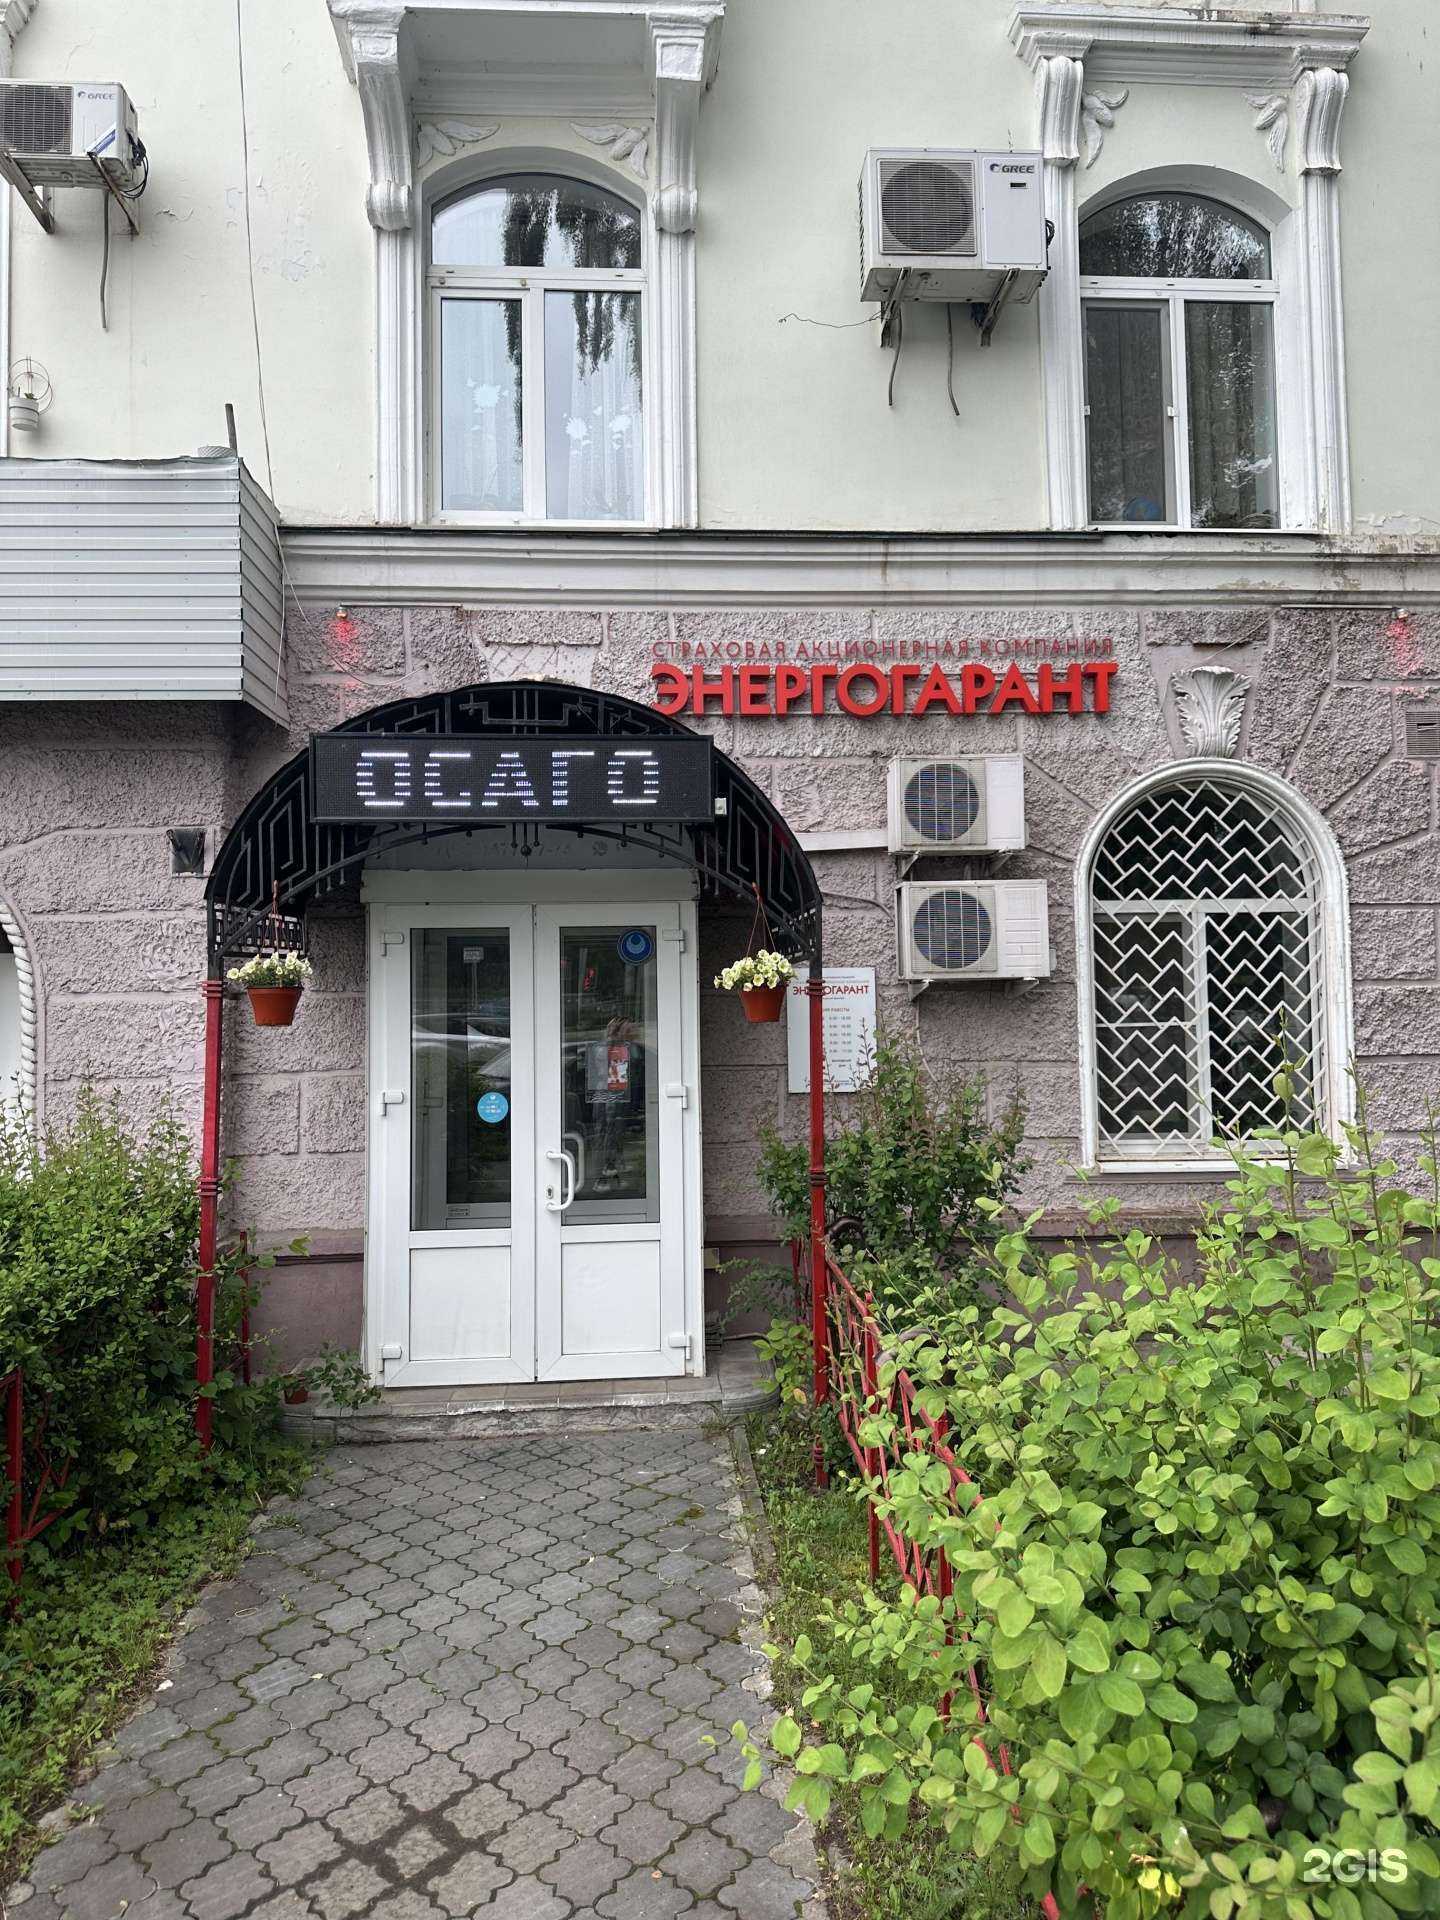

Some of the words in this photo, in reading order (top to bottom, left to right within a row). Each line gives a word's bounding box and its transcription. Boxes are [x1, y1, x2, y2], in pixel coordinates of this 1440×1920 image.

[1001, 164, 1035, 174] GREE
[651, 640, 786, 659] СТРАХОВАЯ
[796, 639, 968, 659] АКЦИОНЕРНАЯ
[980, 637, 1114, 656] КОМПАНИЯ
[650, 661, 1118, 718] ЭНЕРГОГАРАНТ
[356, 750, 660, 808] ОСАГО
[792, 984, 870, 996] ЭНОГАРАНТ
